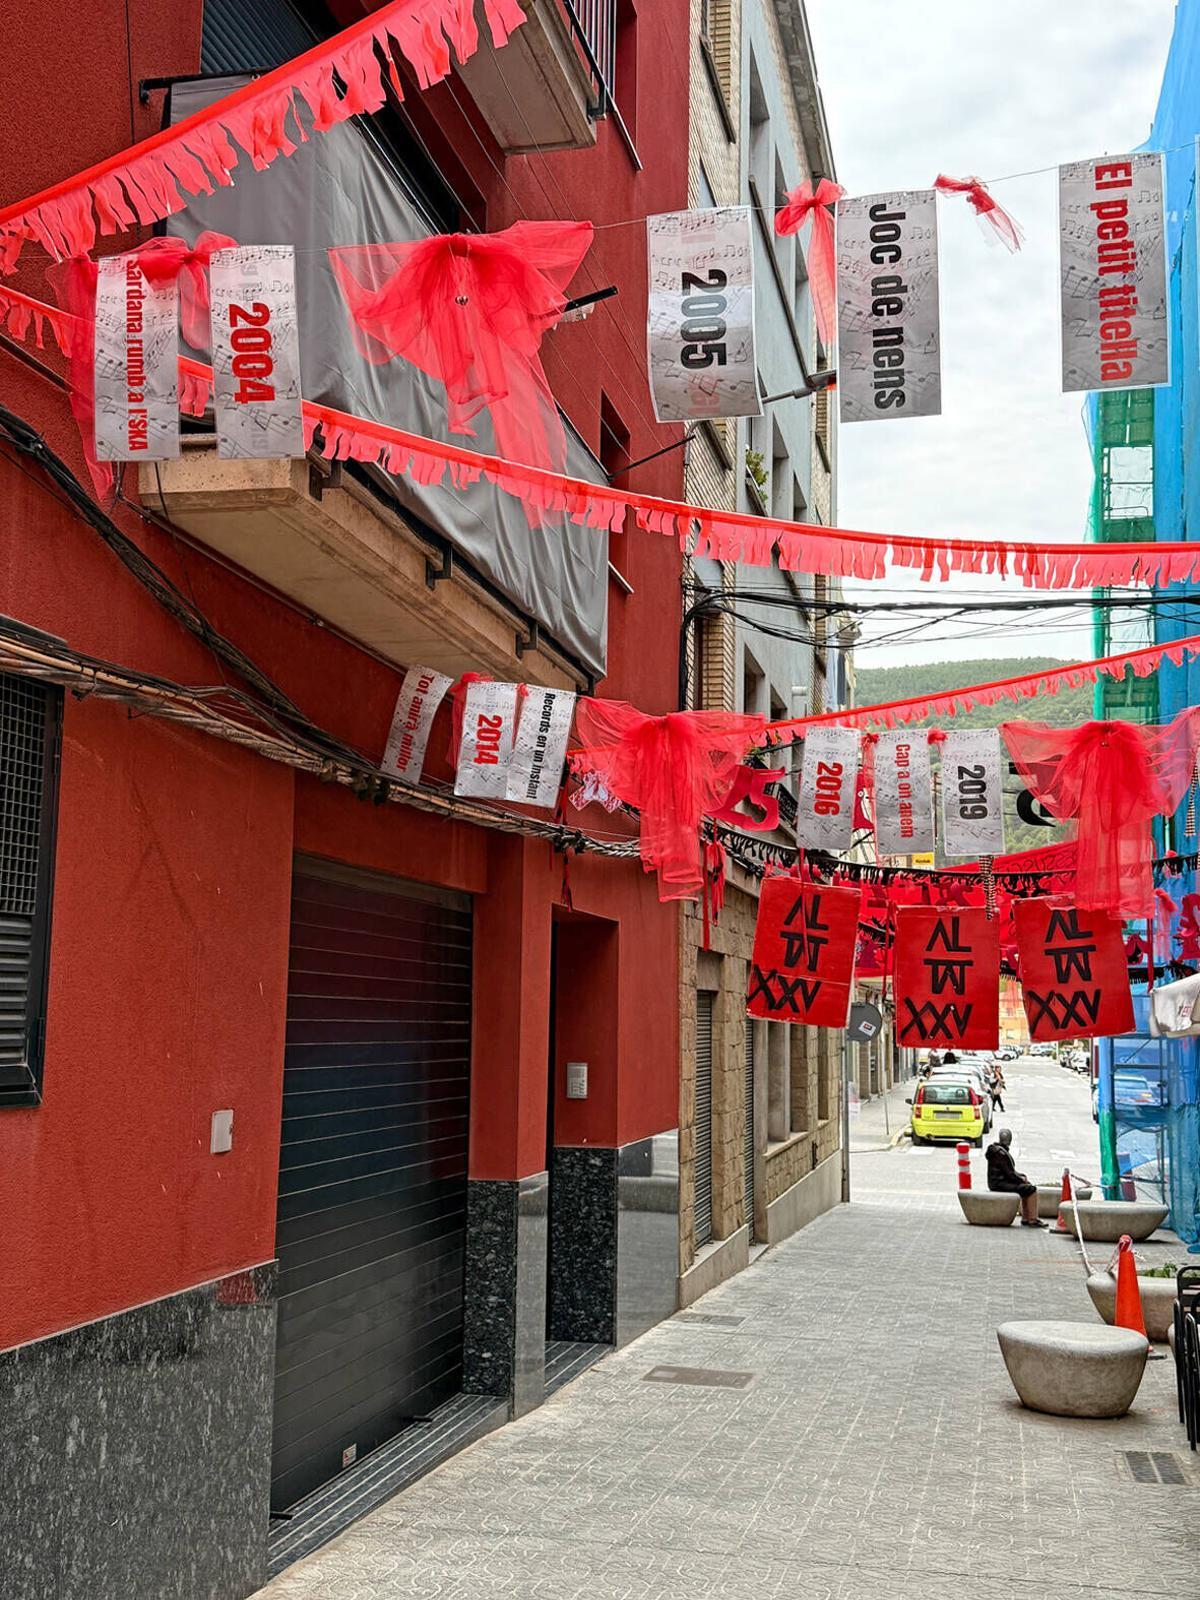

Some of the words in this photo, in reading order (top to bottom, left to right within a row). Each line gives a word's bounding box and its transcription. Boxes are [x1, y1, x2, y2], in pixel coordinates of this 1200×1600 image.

[1095, 161, 1133, 191] El
[869, 203, 906, 265] Joc
[1089, 199, 1136, 277] petit
[871, 275, 908, 317] de
[680, 268, 728, 370] 2005
[1098, 284, 1138, 381] titella
[127, 338, 147, 387] rumb
[229, 302, 276, 405] 2004
[872, 326, 906, 410] nens
[127, 392, 145, 403] a
[127, 409, 149, 451] l'SKA
[418, 674, 434, 694] Tot
[404, 695, 424, 731] anirà
[538, 692, 556, 734] Records
[395, 733, 414, 772] millor
[473, 713, 503, 765] 2014
[533, 749, 544, 762] un
[536, 735, 547, 748] en
[895, 744, 911, 764] Cap
[525, 762, 543, 799] instant
[813, 761, 844, 817] 2016
[898, 770, 910, 779] a
[898, 783, 911, 799] on
[957, 764, 988, 820] 2019
[898, 802, 913, 839] anem
[746, 964, 823, 1013] XXV
[900, 996, 973, 1041] XXV
[1027, 988, 1102, 1036] XXV
